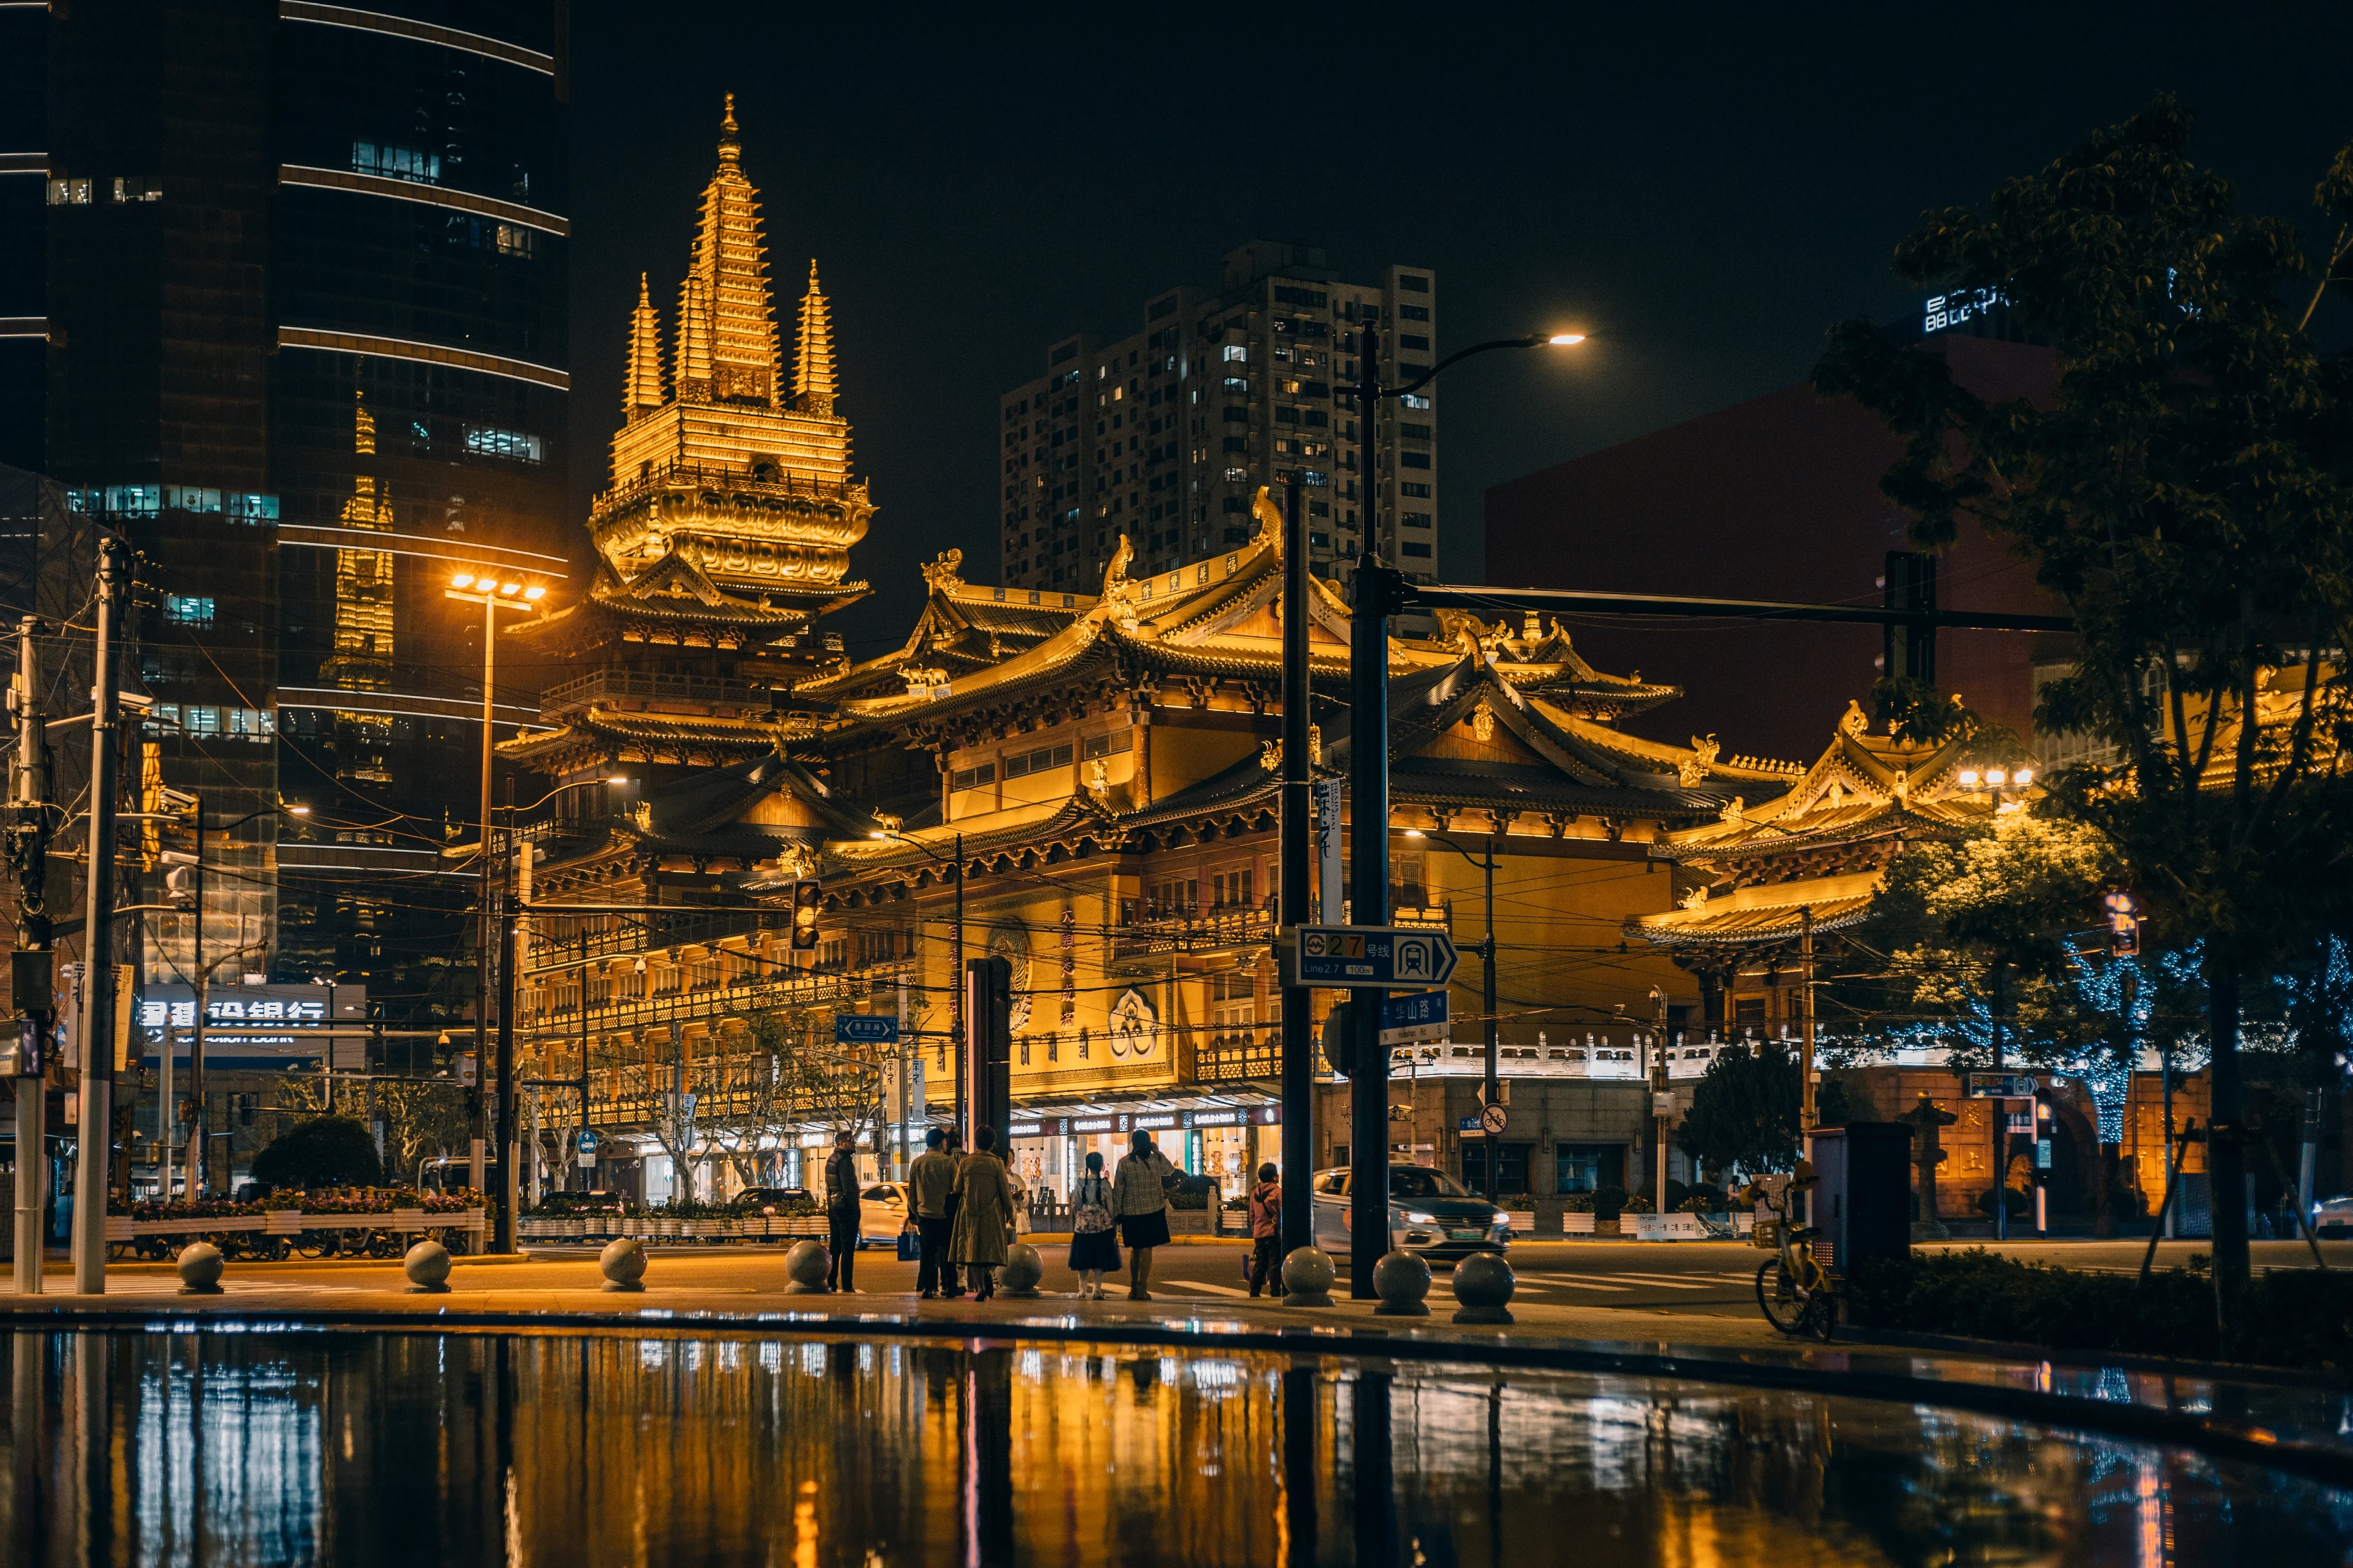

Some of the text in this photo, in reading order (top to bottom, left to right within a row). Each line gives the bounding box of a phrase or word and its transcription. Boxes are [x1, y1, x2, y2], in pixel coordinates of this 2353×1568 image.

[1351, 966, 1370, 974] 100m
[1395, 999, 1429, 1022] 华山路
[855, 1022, 880, 1031] 愚园路
[1437, 1025, 1441, 1034] S
[1384, 1033, 1388, 1041] N
